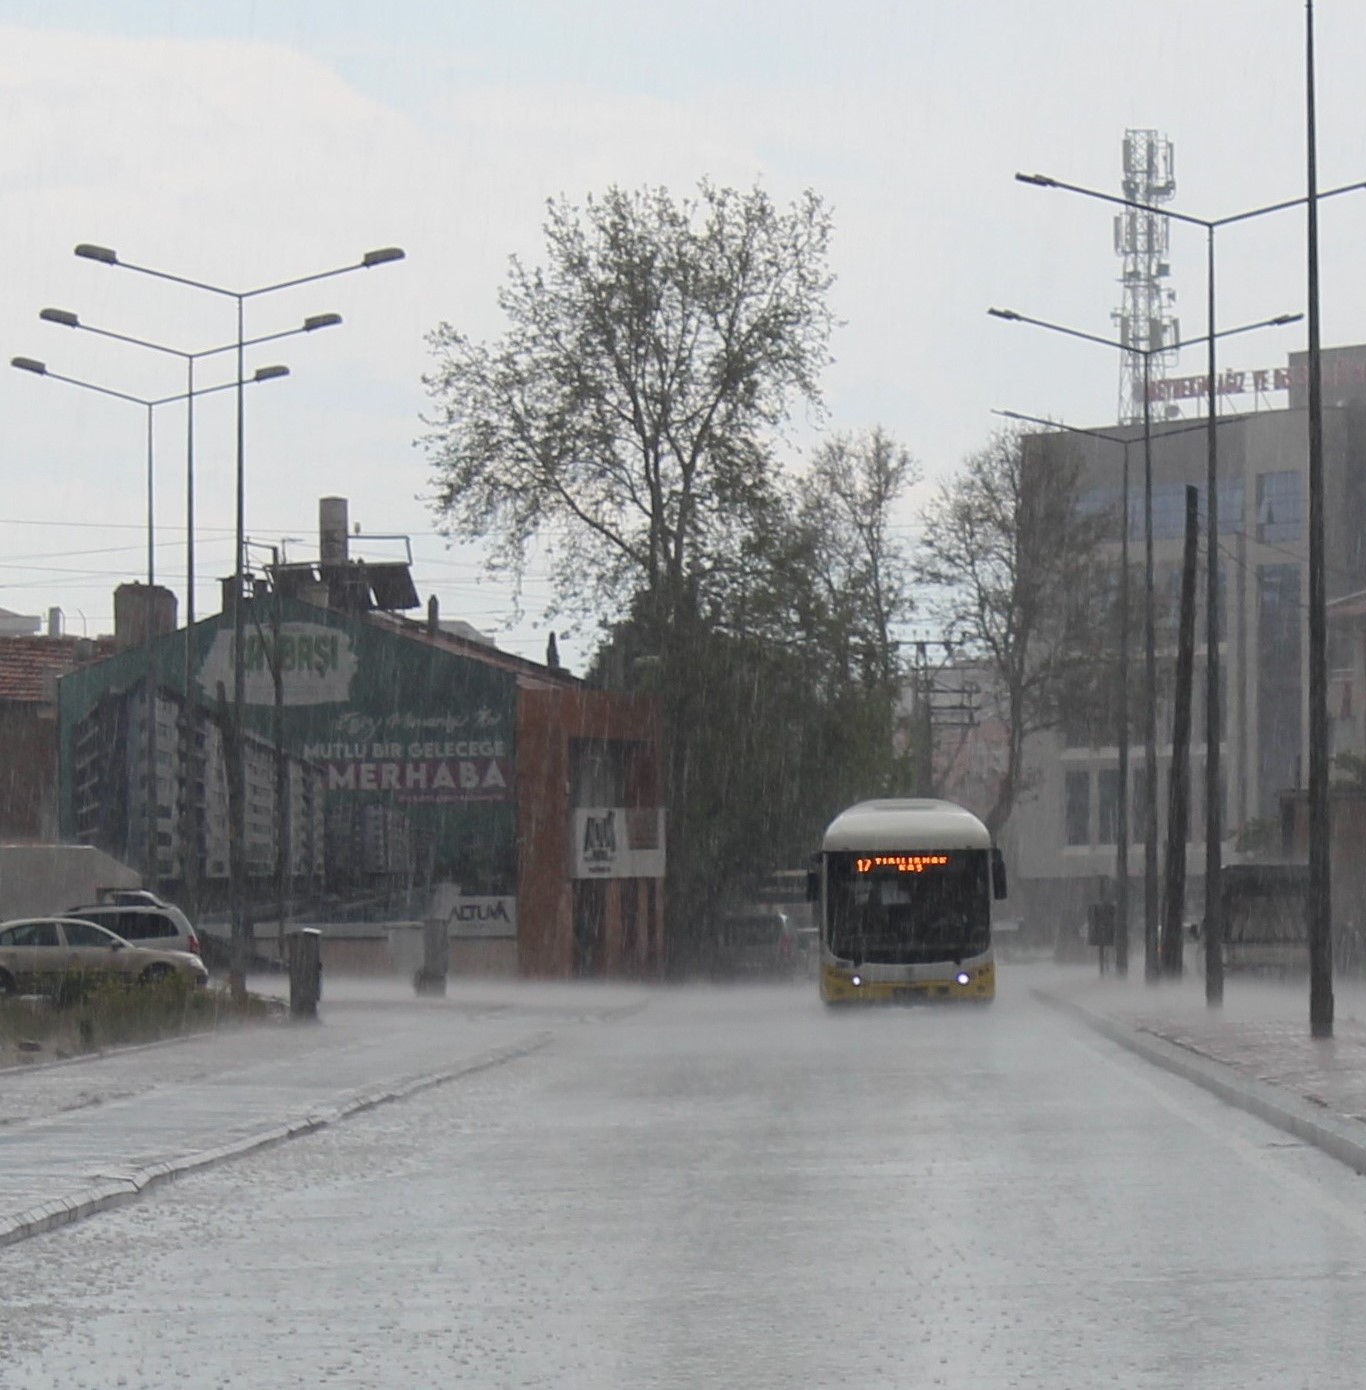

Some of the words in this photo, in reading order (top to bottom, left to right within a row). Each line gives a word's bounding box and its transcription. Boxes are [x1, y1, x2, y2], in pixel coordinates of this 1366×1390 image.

[303, 743, 368, 760] MUTLU
[329, 760, 507, 791] MERHABA
[857, 858, 872, 872] 17
